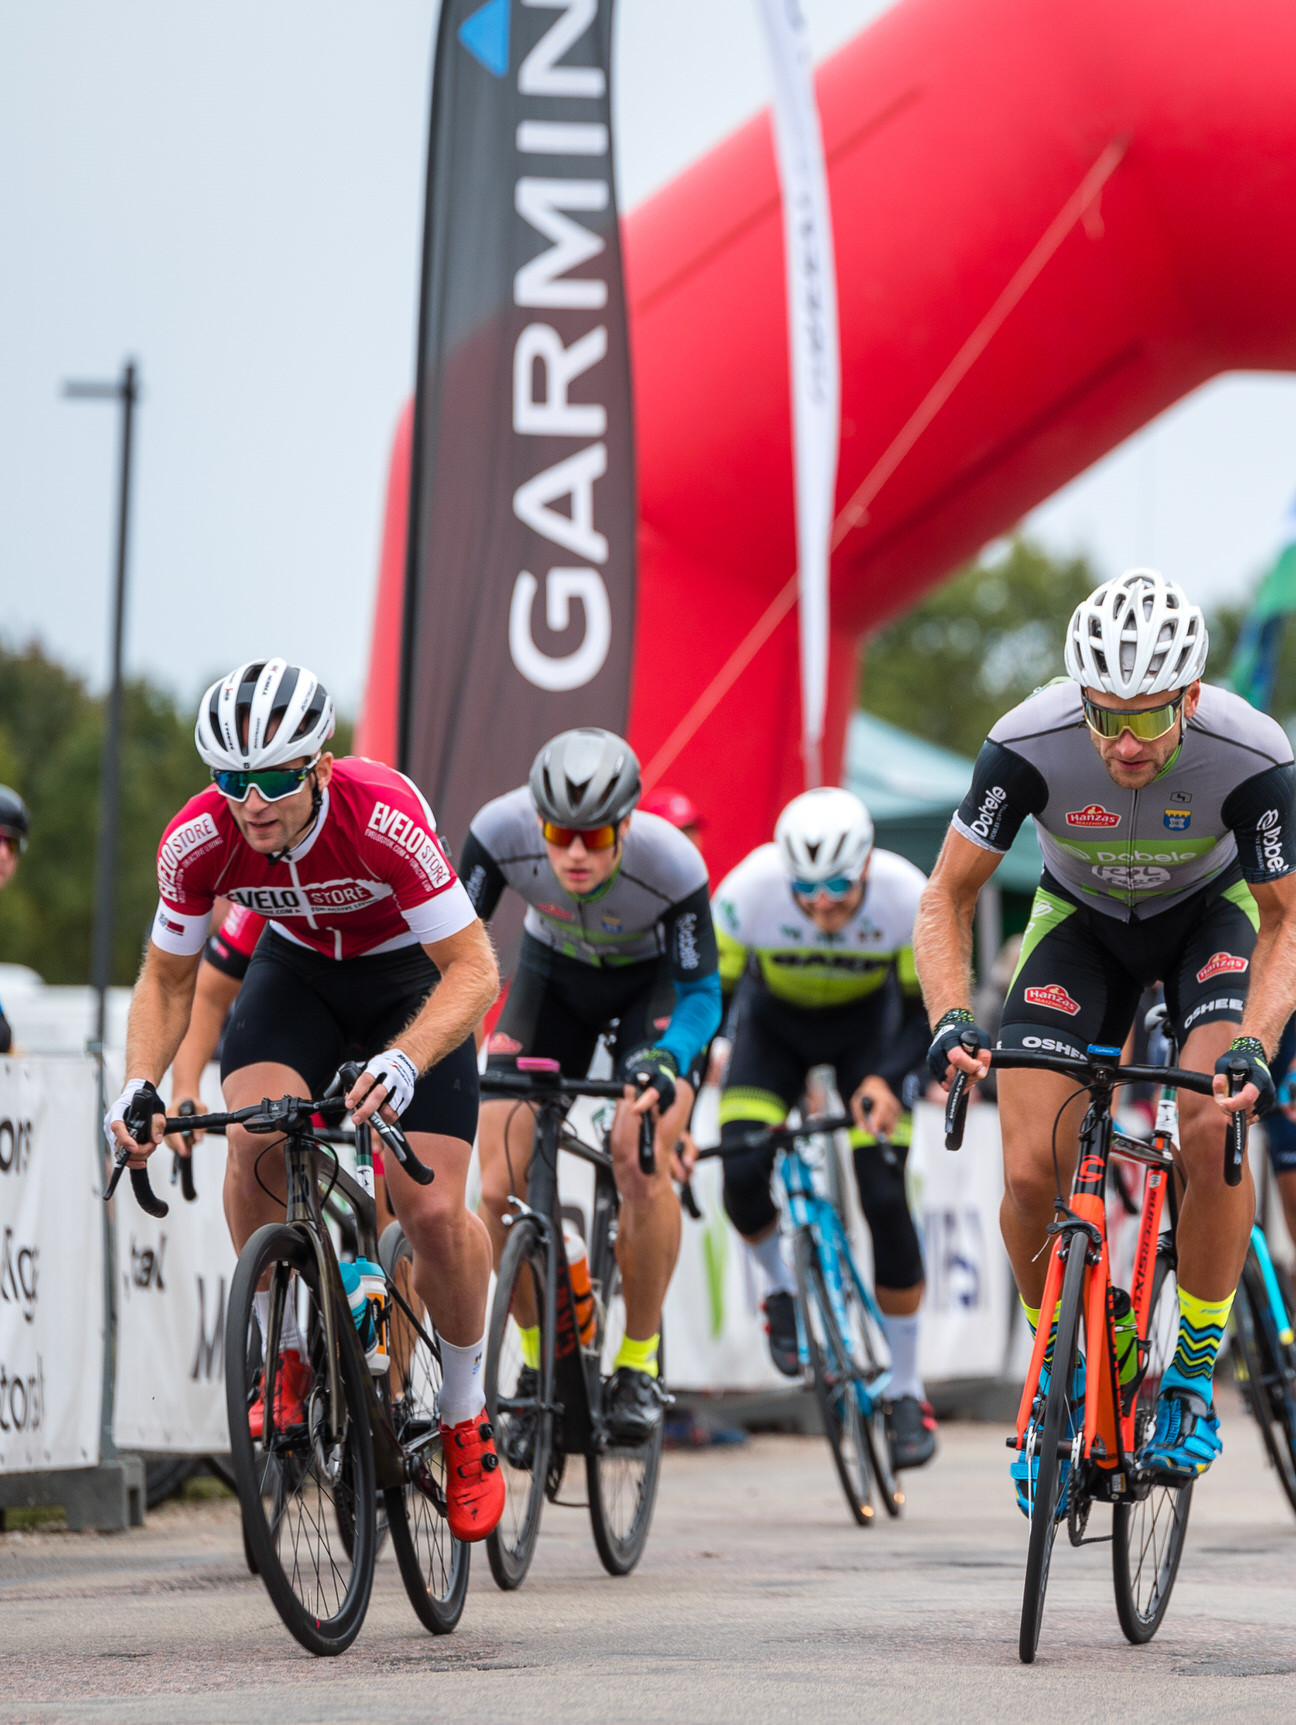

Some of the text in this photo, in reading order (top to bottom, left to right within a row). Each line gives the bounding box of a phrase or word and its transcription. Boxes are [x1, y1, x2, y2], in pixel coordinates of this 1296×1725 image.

[508, 0, 612, 692] GARMIN
[367, 801, 426, 854] EVELO
[1070, 813, 1116, 823] Hanzas
[172, 818, 213, 854] STORE
[1096, 850, 1197, 863] Dobele
[310, 886, 368, 905] STORE
[1200, 960, 1242, 978] Hanzas
[1030, 989, 1076, 1011] Hanzas
[1184, 998, 1244, 1029] OSHEE
